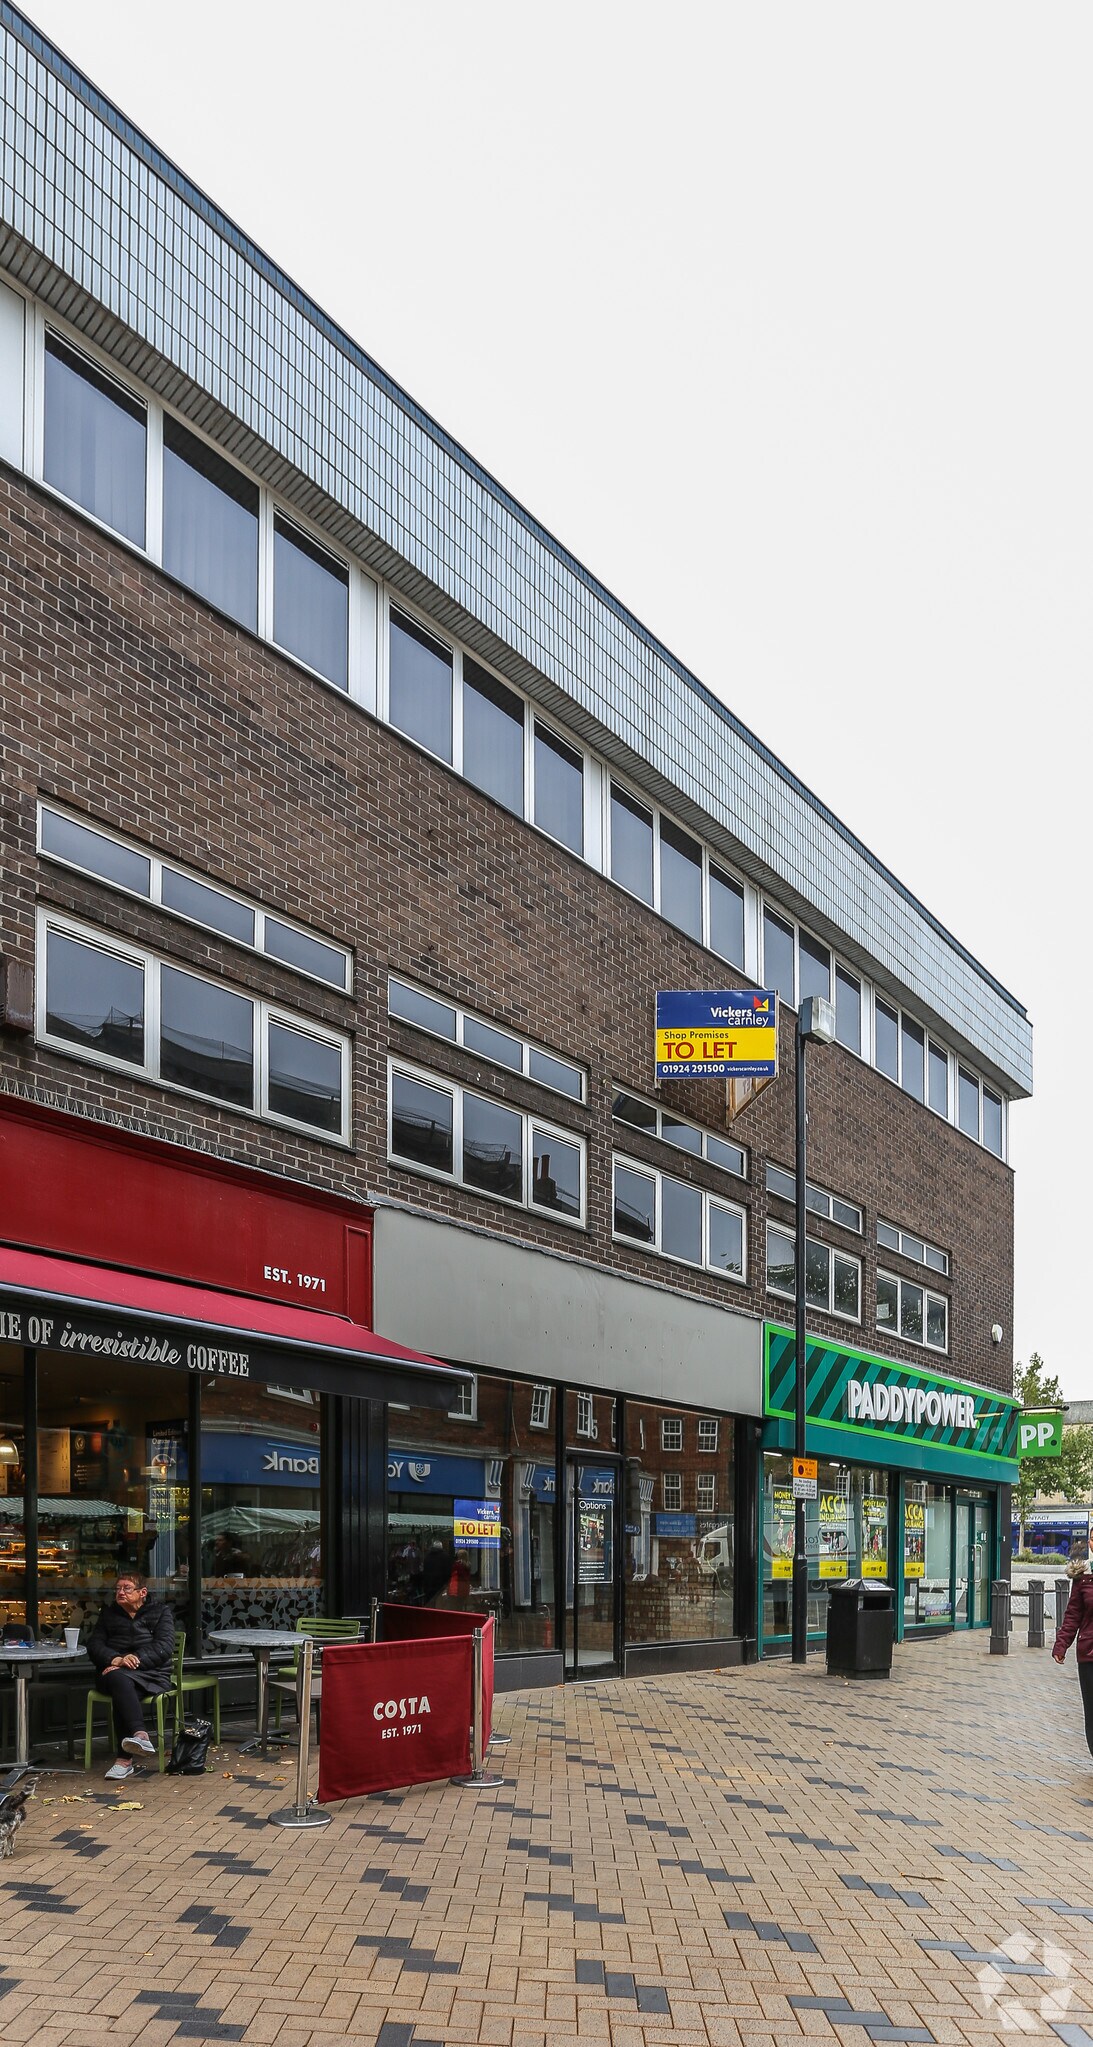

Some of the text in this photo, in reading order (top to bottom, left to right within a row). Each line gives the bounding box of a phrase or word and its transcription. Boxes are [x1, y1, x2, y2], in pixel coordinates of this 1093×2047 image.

[710, 1006, 752, 1018] Vickers
[727, 1014, 769, 1028] carnley
[664, 1030, 729, 1040] Shop Premises
[663, 1041, 738, 1059] TO LET
[662, 1064, 690, 1074] 01924
[691, 1064, 725, 1073] 291500
[263, 1265, 327, 1293] EST. 1971
[27, 1315, 54, 1345] OF
[59, 1321, 182, 1365] irresistible
[186, 1343, 250, 1378] COFFEE
[579, 1500, 607, 1511] Options
[820, 1494, 847, 1514] ACCA
[820, 1512, 847, 1523] INSURANCE
[460, 1522, 496, 1536] TO LET
[373, 1696, 431, 1721] COSTA
[381, 1724, 422, 1740] EST. 1971
